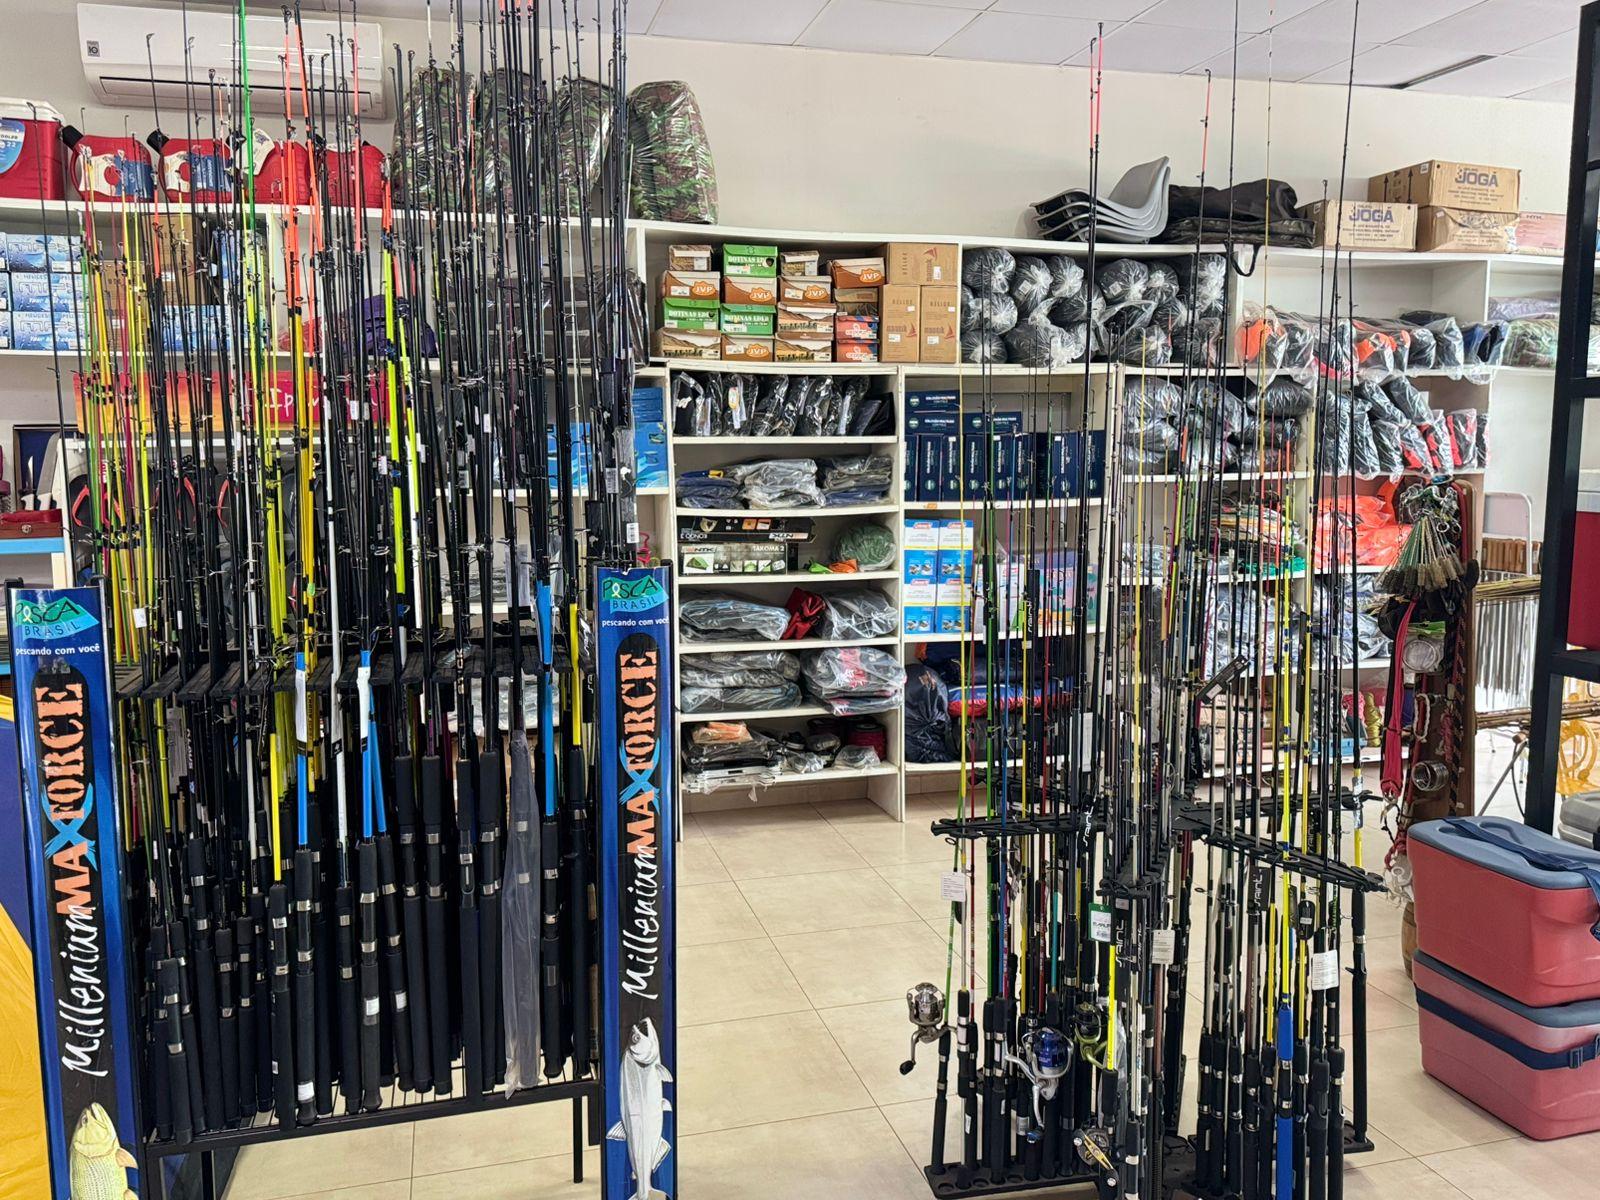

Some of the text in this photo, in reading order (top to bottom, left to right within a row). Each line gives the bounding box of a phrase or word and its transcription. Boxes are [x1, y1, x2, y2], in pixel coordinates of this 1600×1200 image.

[863, 272, 880, 280] JVP
[749, 348, 767, 356] JVP
[612, 597, 658, 610] BRASIL
[24, 620, 81, 637] BRASIL
[601, 619, 637, 628] pescando
[638, 618, 654, 626] com
[15, 643, 101, 657] pescando com você
[621, 844, 660, 1000] Millenium
[58, 903, 109, 1078] Millenium
